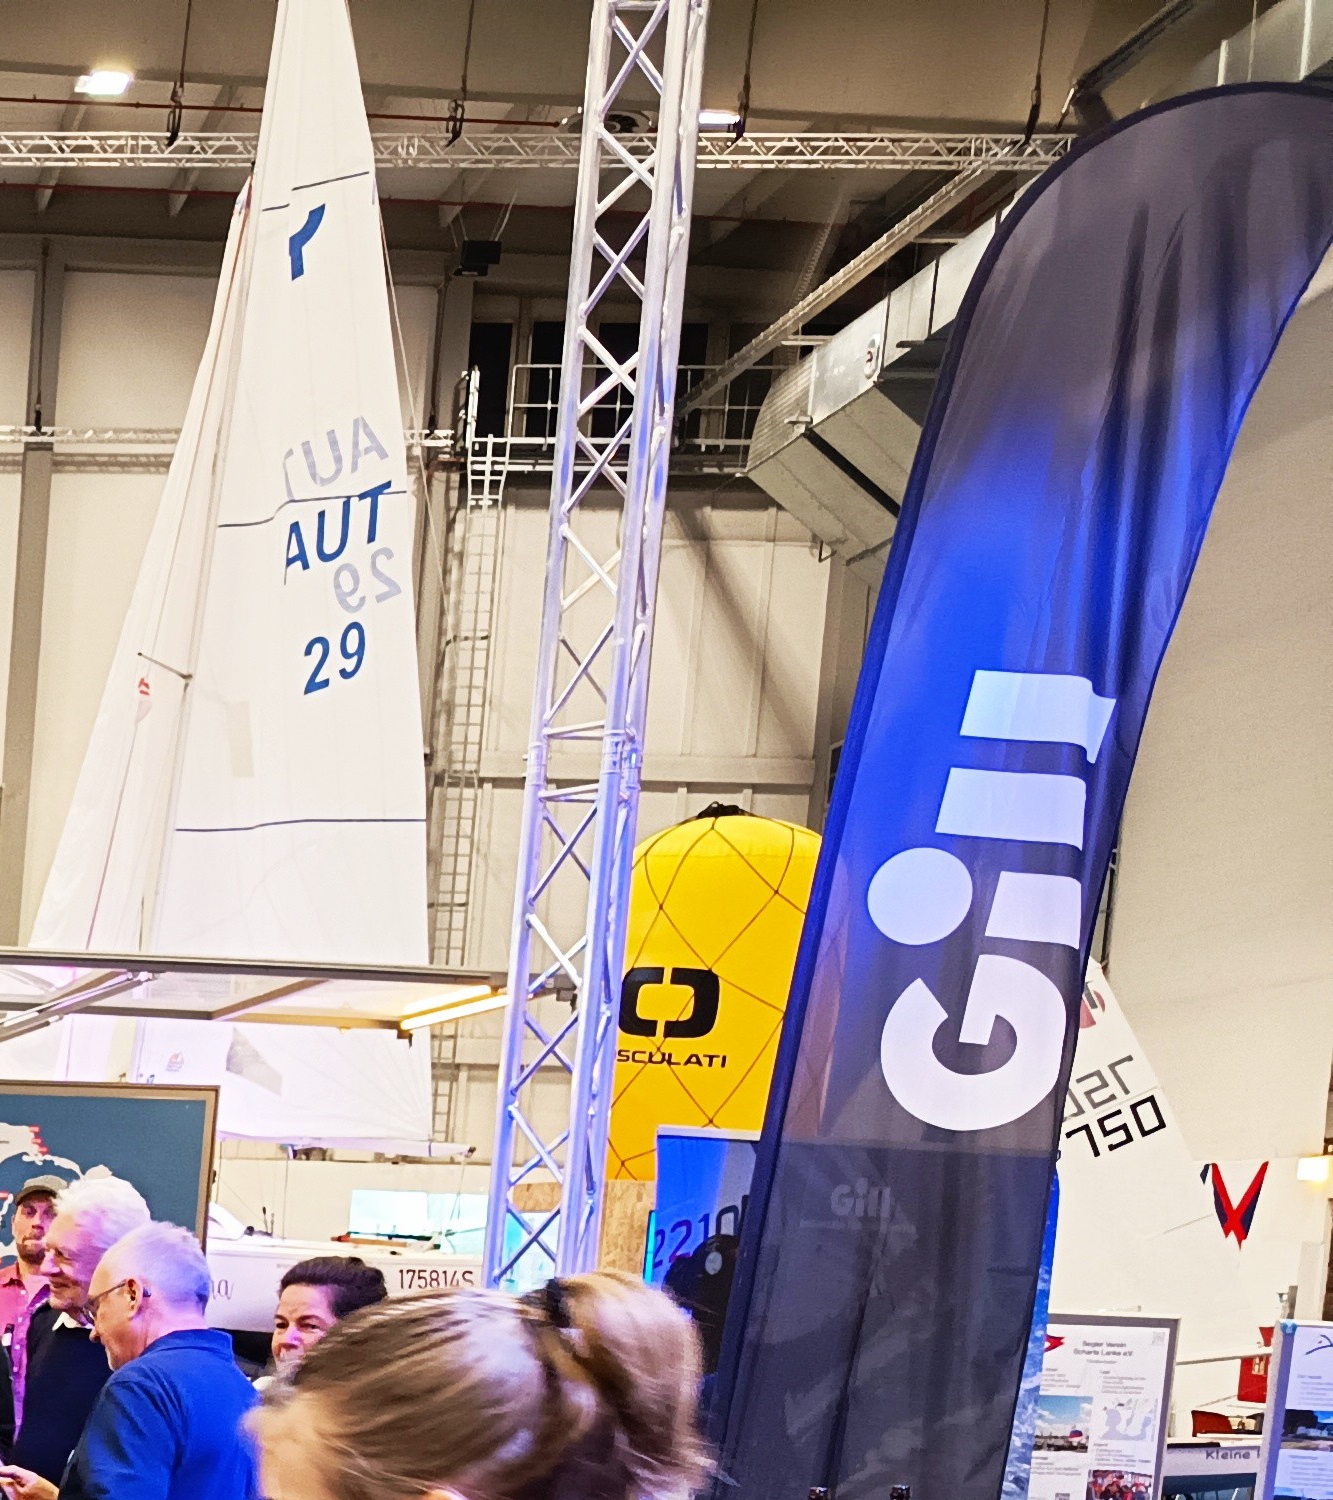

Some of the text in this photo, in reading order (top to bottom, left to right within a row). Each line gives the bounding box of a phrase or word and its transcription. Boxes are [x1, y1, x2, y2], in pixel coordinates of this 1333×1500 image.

[284, 480, 392, 586] AUT
[304, 621, 366, 695] 29
[867, 670, 1117, 1132] Gill
[617, 1049, 727, 1068] SCULATI
[1065, 1094, 1167, 1158] 750
[1205, 1449, 1251, 1460] Kleine
